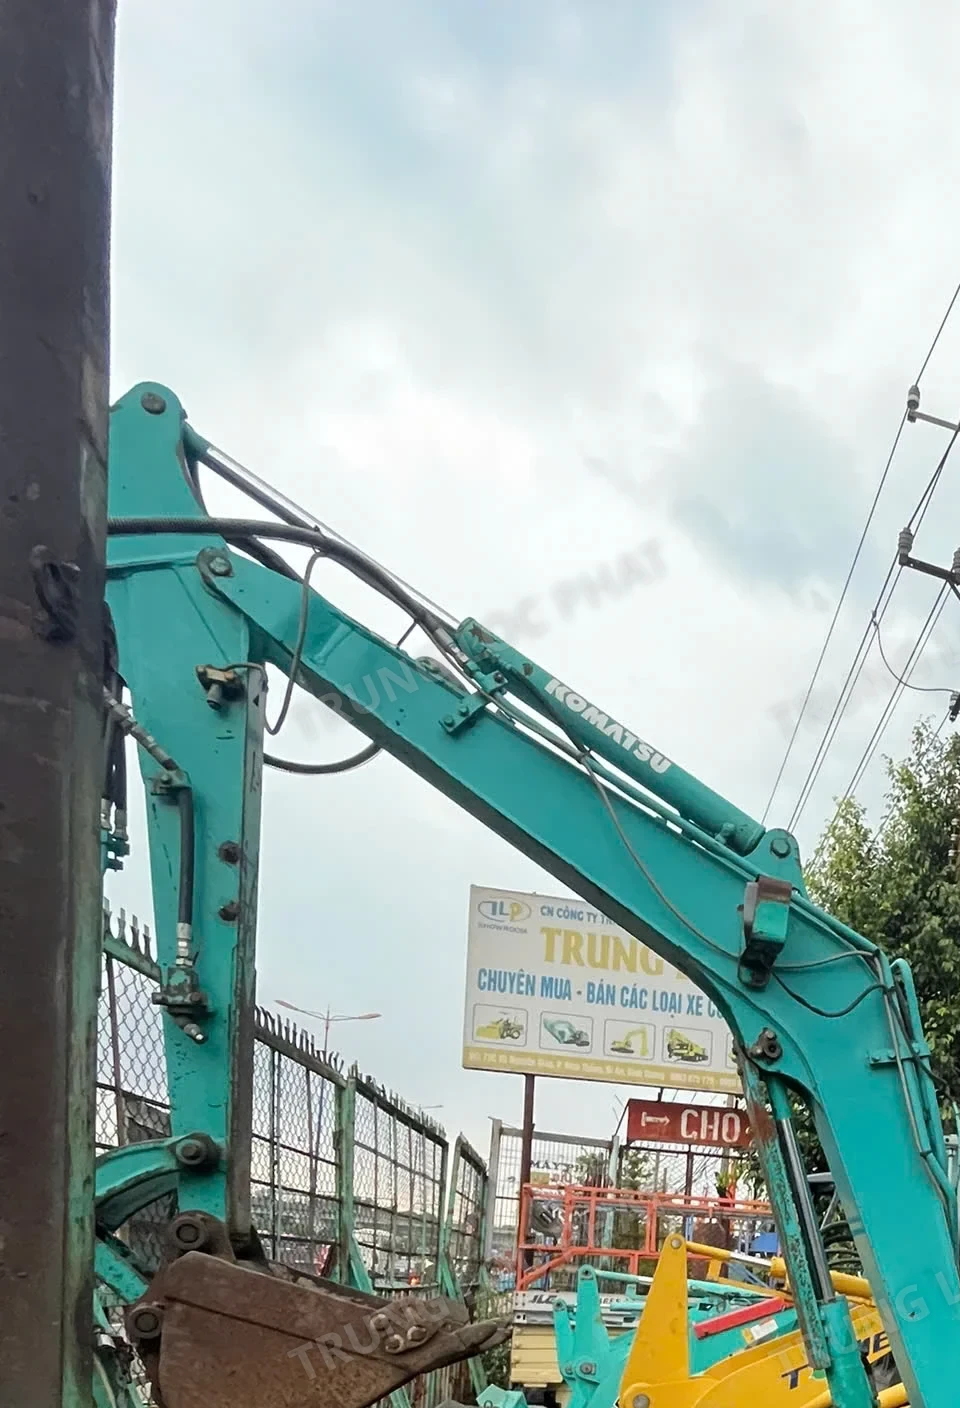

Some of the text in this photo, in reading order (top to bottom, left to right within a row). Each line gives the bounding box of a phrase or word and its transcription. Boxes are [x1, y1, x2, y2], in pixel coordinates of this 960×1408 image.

[544, 678, 671, 773] KOMATSU
[556, 905, 583, 921] CÔNG
[587, 911, 598, 923] TY
[540, 927, 664, 976] TRUNG
[478, 968, 536, 996] CHUYÊN
[540, 975, 572, 1000] MUA
[586, 979, 615, 1006] BÁN
[621, 983, 648, 1009] CÁC
[652, 989, 681, 1018] LOẠI
[686, 994, 703, 1016] XE
